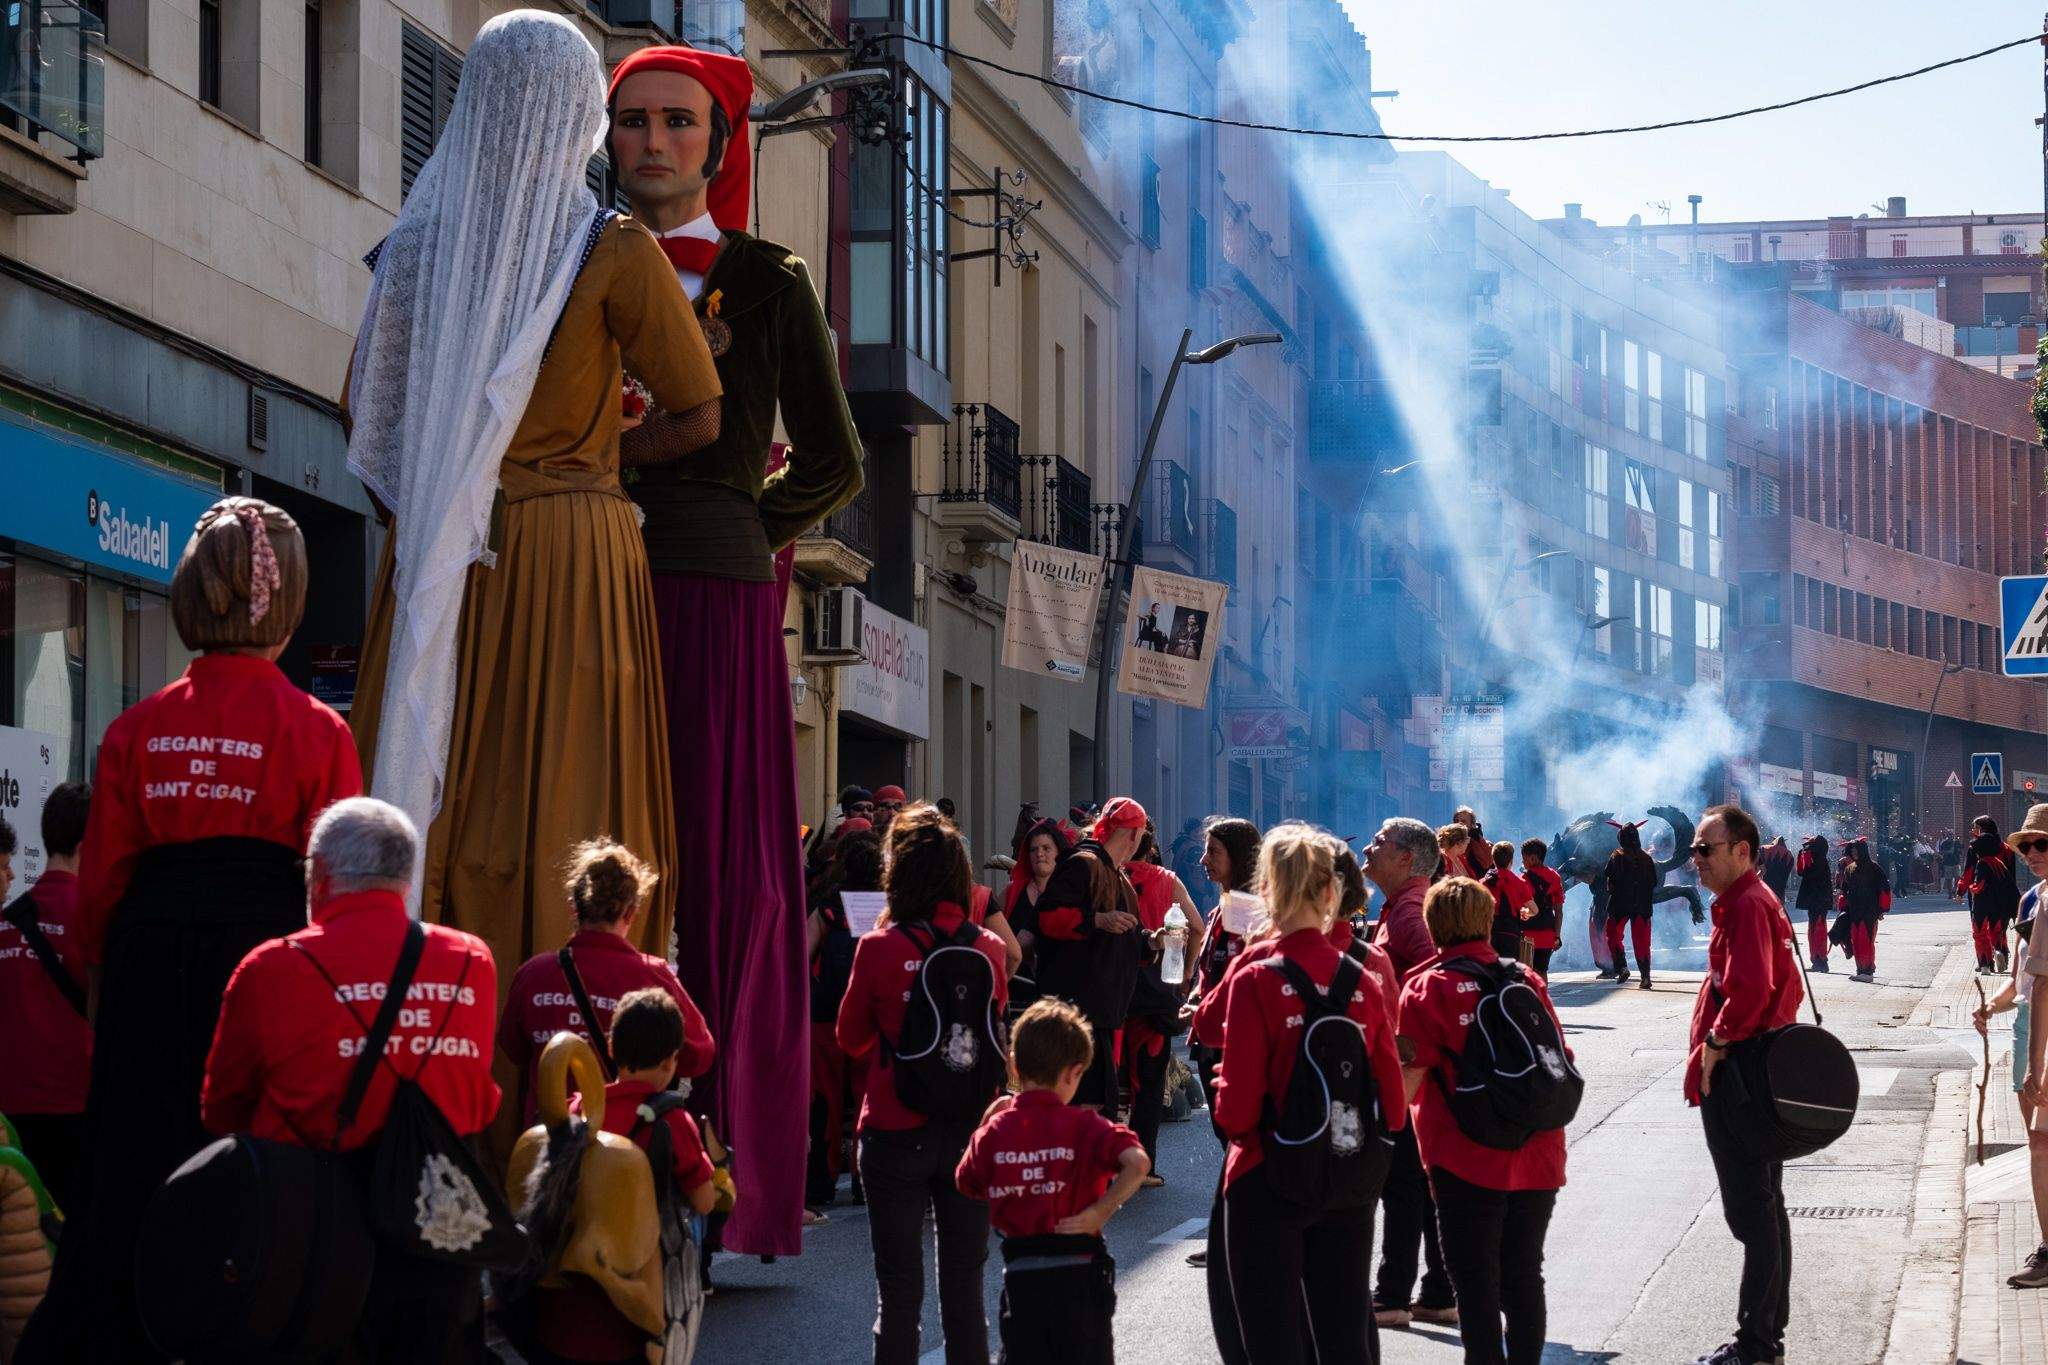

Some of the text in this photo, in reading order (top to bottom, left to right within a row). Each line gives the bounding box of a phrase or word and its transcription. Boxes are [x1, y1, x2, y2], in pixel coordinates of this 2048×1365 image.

[98, 500, 169, 570] Sabadell
[190, 758, 217, 776] DE
[145, 781, 192, 799] SANT
[334, 981, 476, 1007] GEGNTERS
[399, 1008, 432, 1028] DE
[993, 1146, 1075, 1164] EGANTERS
[1022, 1166, 1045, 1181] DE
